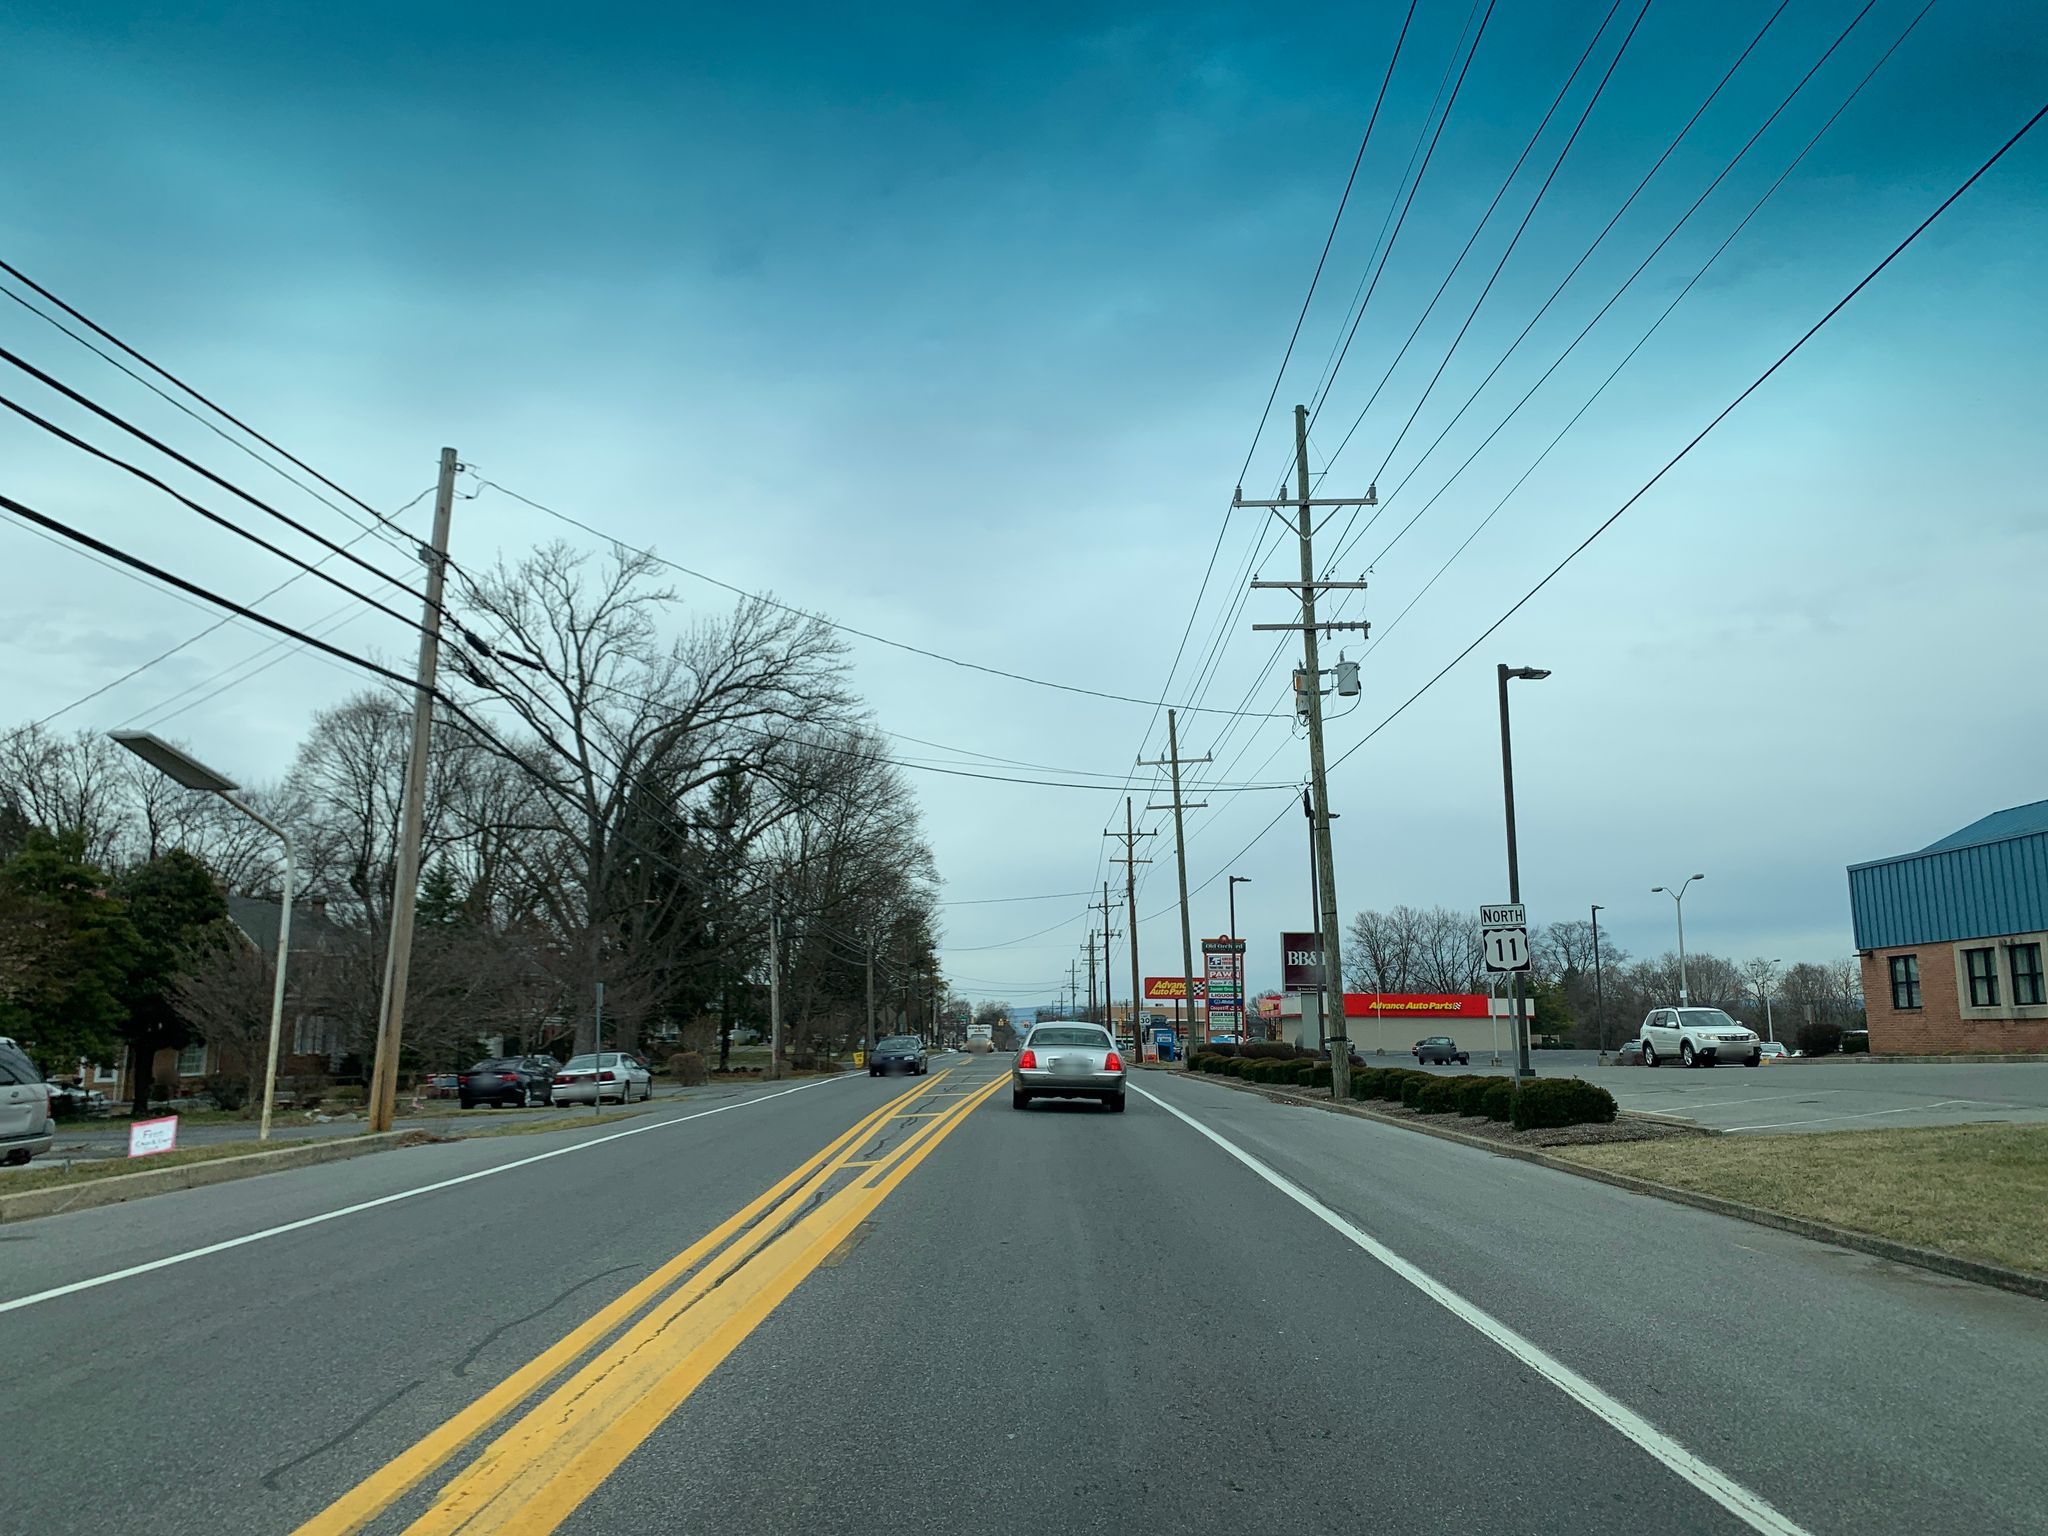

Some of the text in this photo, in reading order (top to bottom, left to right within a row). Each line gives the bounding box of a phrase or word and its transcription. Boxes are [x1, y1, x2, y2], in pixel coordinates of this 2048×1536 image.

[1483, 909, 1523, 923] NORTH
[1496, 938, 1517, 962] 11
[1154, 980, 1187, 989] Advanc
[1149, 988, 1187, 996] Auto Part
[1369, 1002, 1453, 1010] Advance Auto Parts
